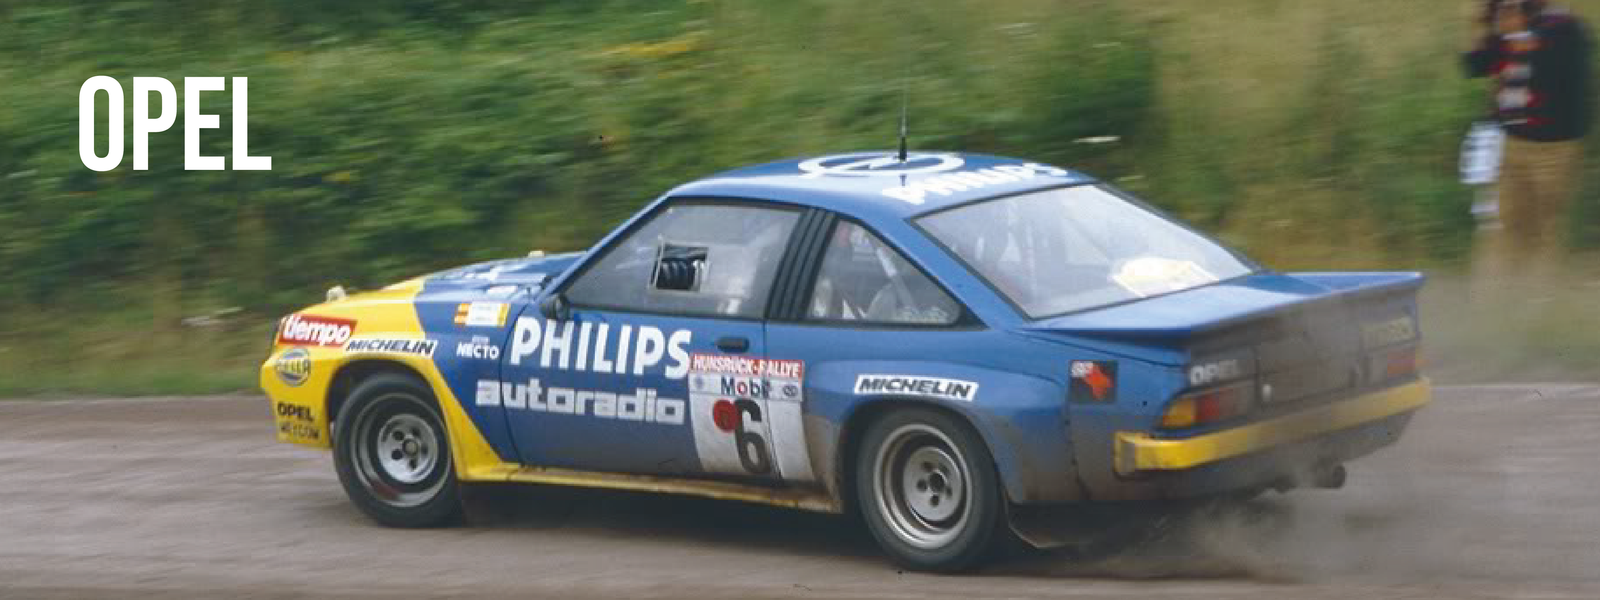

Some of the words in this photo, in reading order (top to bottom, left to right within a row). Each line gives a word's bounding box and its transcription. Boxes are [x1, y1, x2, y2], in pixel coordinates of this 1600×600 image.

[346, 339, 435, 355] MICHELIN
[510, 316, 692, 379] PHILIPS
[475, 378, 685, 425] autoradio
[858, 377, 972, 398] MICHELIN
[277, 402, 314, 422] OPEL
[734, 398, 771, 474] 6
